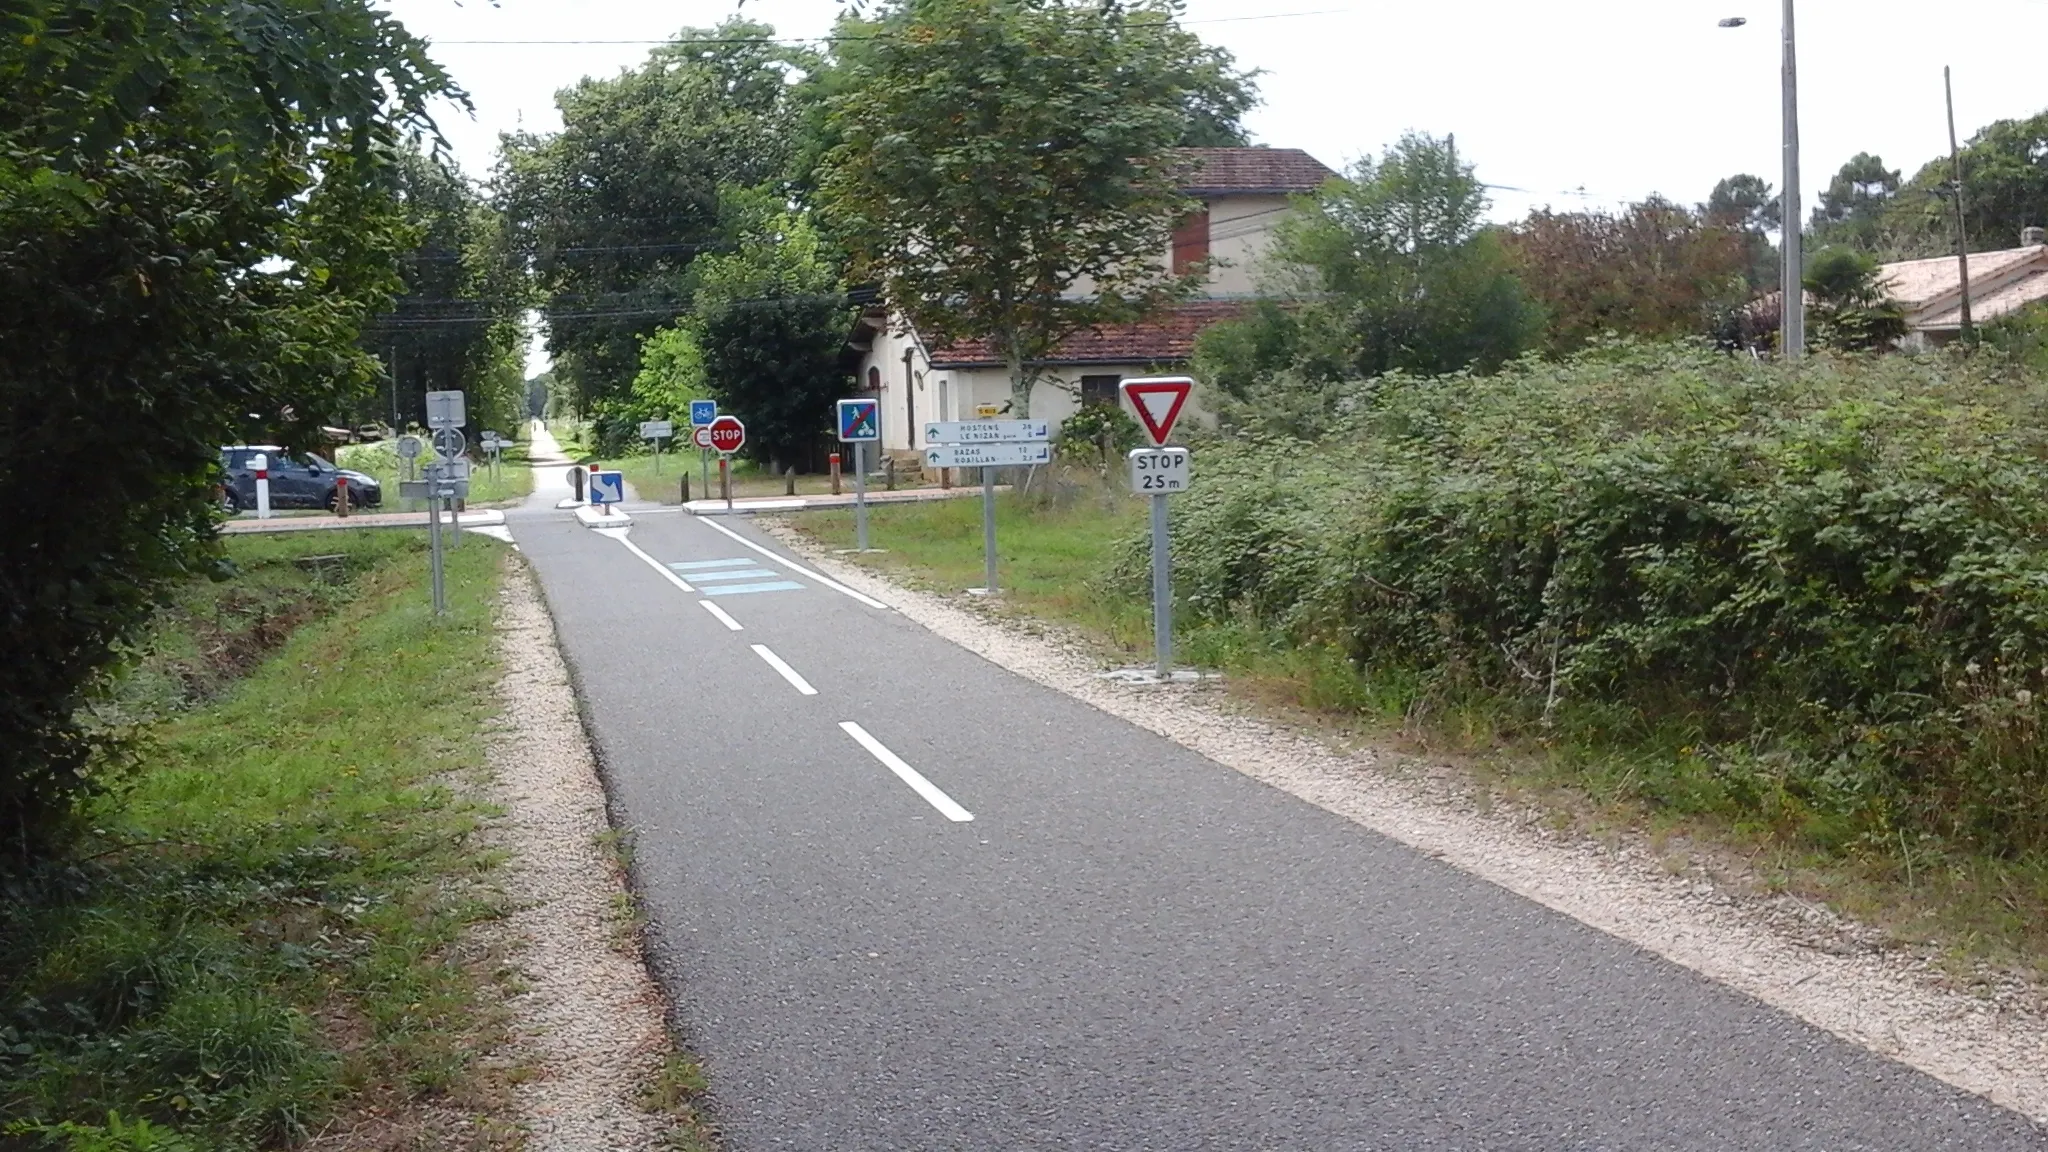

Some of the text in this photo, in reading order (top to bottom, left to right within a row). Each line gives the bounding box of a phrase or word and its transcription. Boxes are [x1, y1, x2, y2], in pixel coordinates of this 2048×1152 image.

[713, 430, 740, 441] STOP
[954, 448, 980, 456] BAZAS
[1138, 455, 1183, 469] STOP
[1143, 475, 1180, 489] 25 m
